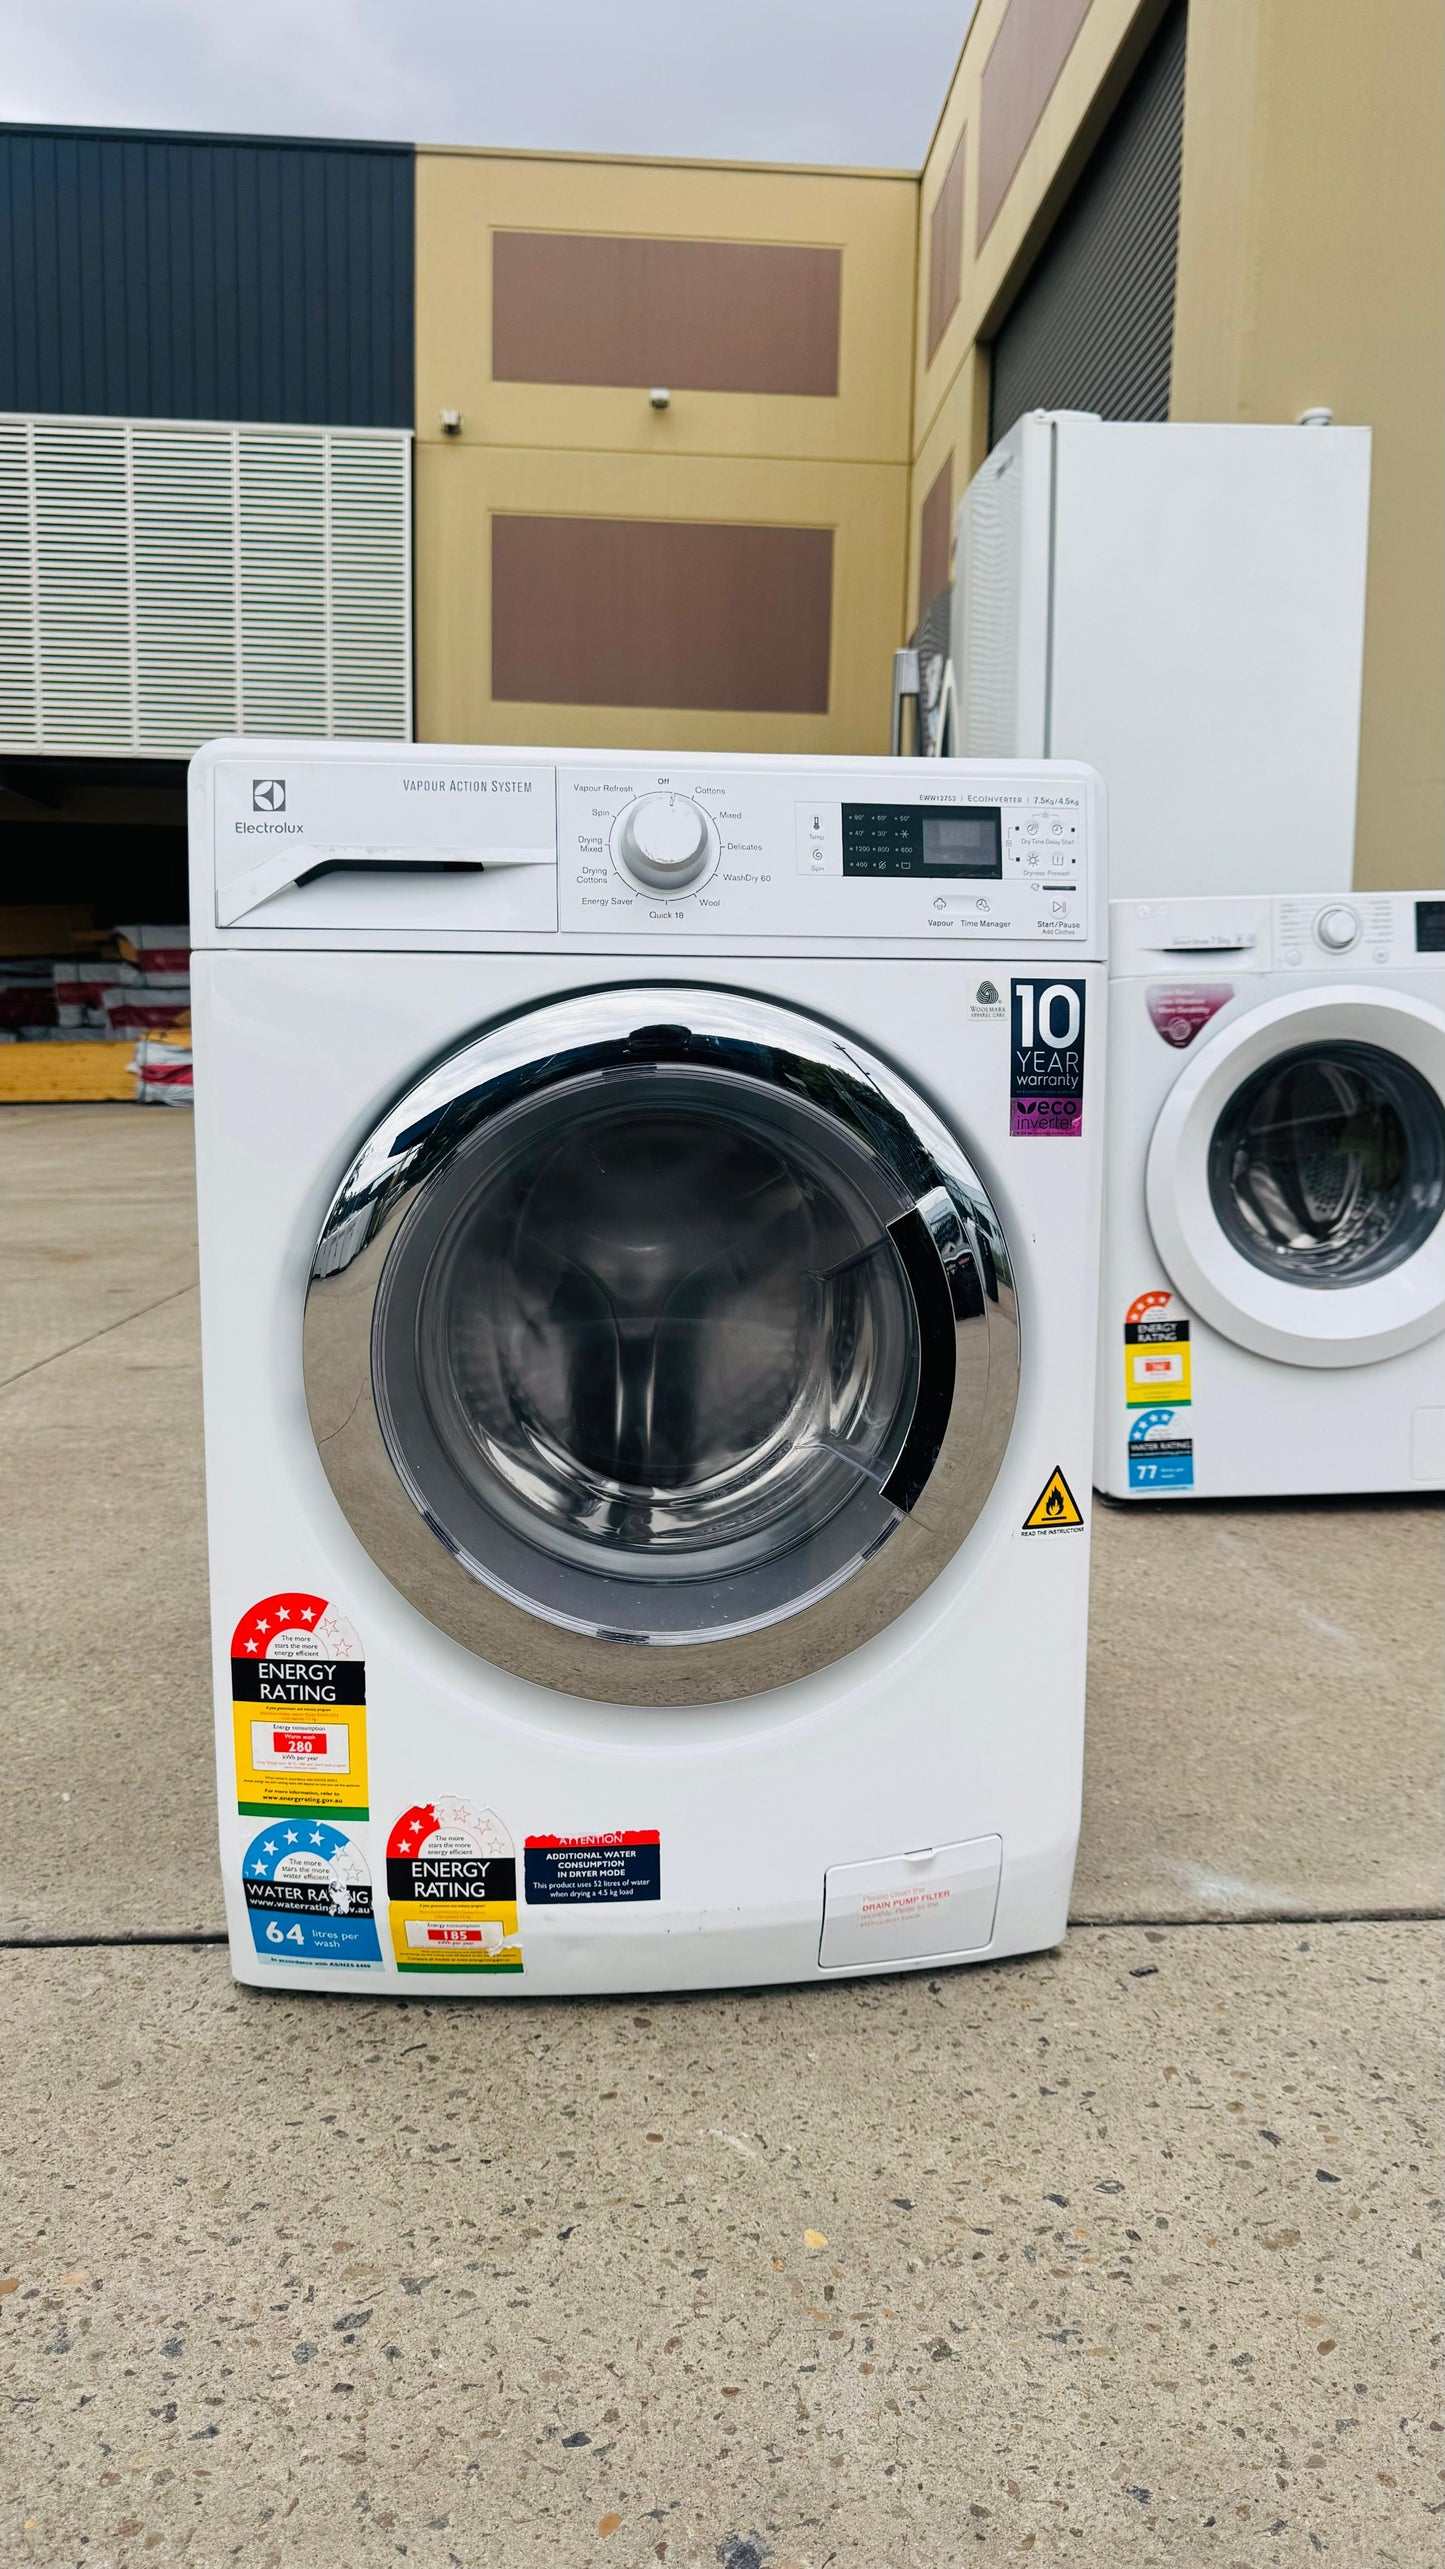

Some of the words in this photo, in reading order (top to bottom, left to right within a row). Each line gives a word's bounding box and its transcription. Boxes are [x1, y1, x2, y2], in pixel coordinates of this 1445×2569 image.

[403, 779, 446, 792] VAPOUR
[449, 779, 487, 792] ACTION
[492, 780, 532, 793] SYSTEM
[695, 787, 725, 795] Cottons
[592, 809, 609, 817] Spin
[720, 811, 742, 819] Mixed
[235, 822, 304, 834] Electrolux
[578, 836, 602, 845] Drying
[580, 845, 602, 853] Mixed
[727, 843, 762, 851] Delicates
[582, 867, 607, 876] Drying
[723, 874, 759, 883] WashDry
[582, 898, 609, 906] Energy
[699, 899, 720, 907] Wool
[649, 912, 672, 920] Quick
[928, 920, 953, 928] Vapour
[980, 920, 1010, 929] Manager
[1016, 984, 1081, 1049] 10
[1016, 1051, 1079, 1073] YEAR
[1017, 1075, 1078, 1089] warranty
[1038, 1101, 1076, 1115] eco
[1137, 1323, 1178, 1333] ENERGY
[1137, 1332, 1177, 1342] RATING
[1137, 1464, 1157, 1480] 77
[259, 1663, 337, 1680] ENERGY
[260, 1684, 336, 1701] RATING
[288, 1741, 312, 1752] 280
[412, 1862, 490, 1877] ENERGY
[558, 1861, 624, 1869] CONSUMPTION
[569, 1870, 597, 1878] DRYER
[415, 1882, 485, 1897] RATING
[549, 1882, 575, 1890] product
[247, 1884, 303, 1900] WATER
[308, 1889, 368, 1904] RANG
[862, 1901, 890, 1912] DRAIN
[893, 1896, 919, 1907] PUMP
[921, 1890, 950, 1901] FILTER
[265, 1921, 304, 1945] 64
[312, 1930, 338, 1939] litres
[342, 1932, 359, 1941] per
[444, 1931, 467, 1940] 185
[314, 1940, 340, 1948] wash
